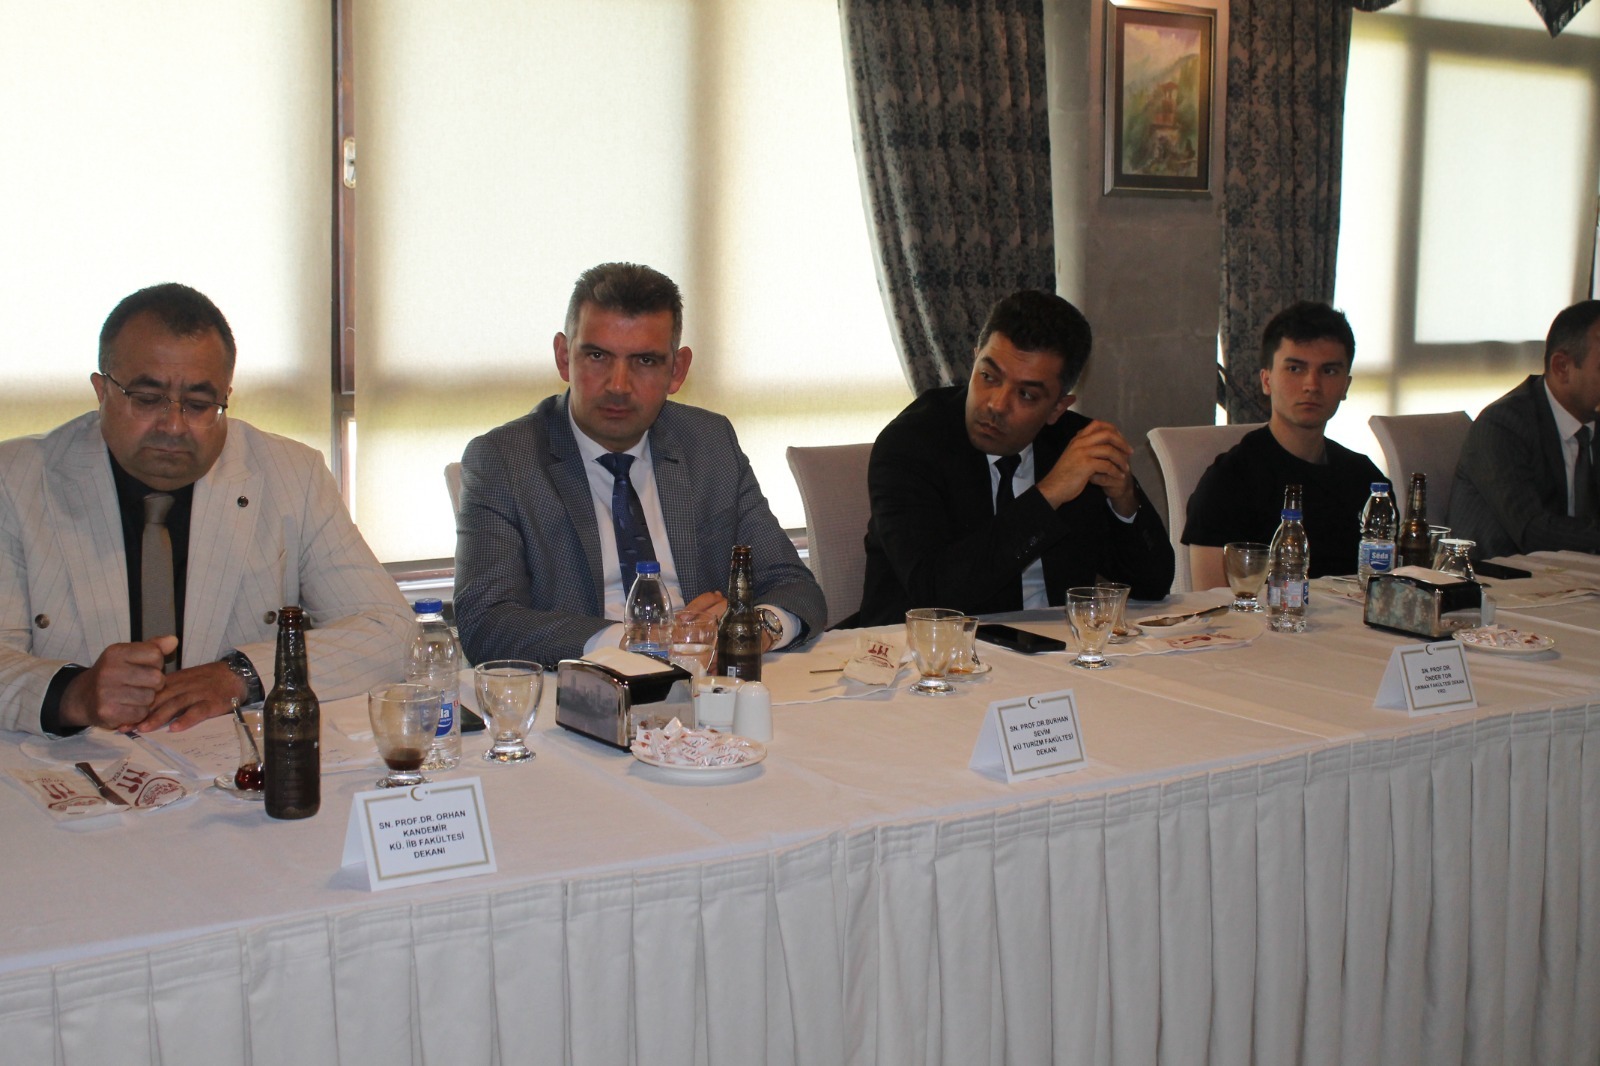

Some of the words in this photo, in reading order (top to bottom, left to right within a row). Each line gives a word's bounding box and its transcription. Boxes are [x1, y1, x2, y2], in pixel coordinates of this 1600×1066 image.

[378, 821, 394, 830] SN.
[436, 810, 466, 821] ORHAN
[403, 823, 448, 837] KANDEMİR
[389, 841, 405, 851] KÜ.
[419, 831, 465, 846] FAKÜLTESİ
[413, 847, 446, 859] DEKANI
